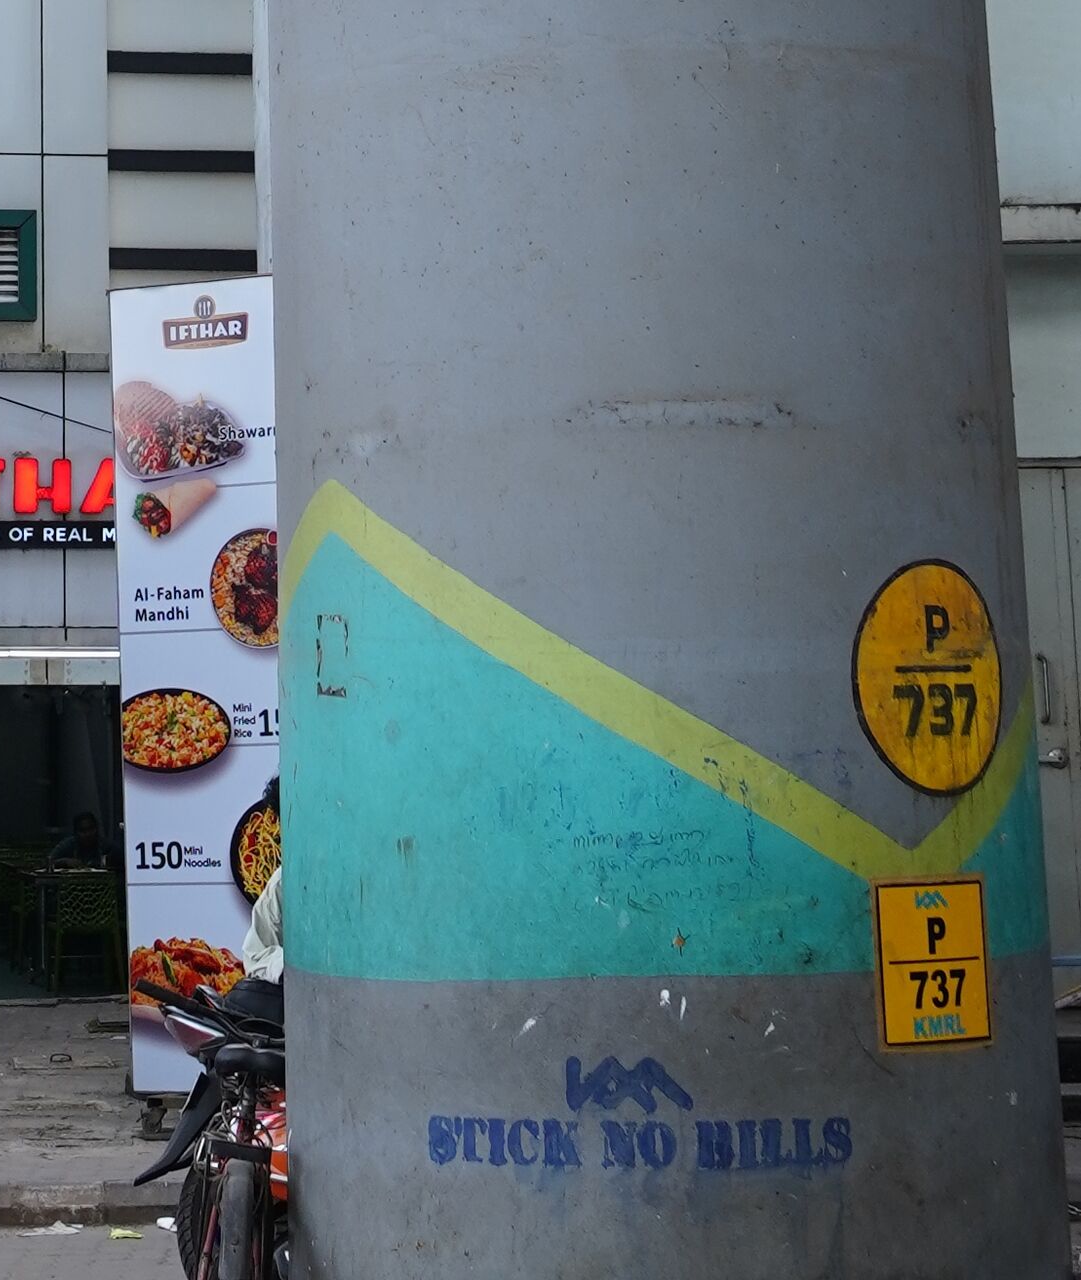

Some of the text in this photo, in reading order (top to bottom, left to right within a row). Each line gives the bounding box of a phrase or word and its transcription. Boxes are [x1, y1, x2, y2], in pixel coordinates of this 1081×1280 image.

[169, 320, 242, 341] IFTHAR
[9, 527, 34, 541] OF
[43, 527, 92, 541] REAL
[134, 586, 204, 602] Al-Faham
[135, 606, 189, 622] Mandhi
[925, 604, 950, 653] P
[233, 704, 252, 713] Mini
[892, 683, 978, 737] 737
[233, 716, 256, 725] Fried
[233, 729, 252, 738] Rice
[135, 841, 182, 869] 150
[184, 846, 203, 855] Mini
[184, 858, 221, 868] Noodles
[927, 917, 946, 955] P
[909, 968, 966, 1009] 737
[913, 1013, 966, 1039] KMRL
[427, 1115, 853, 1170] STICK NO BILLS
